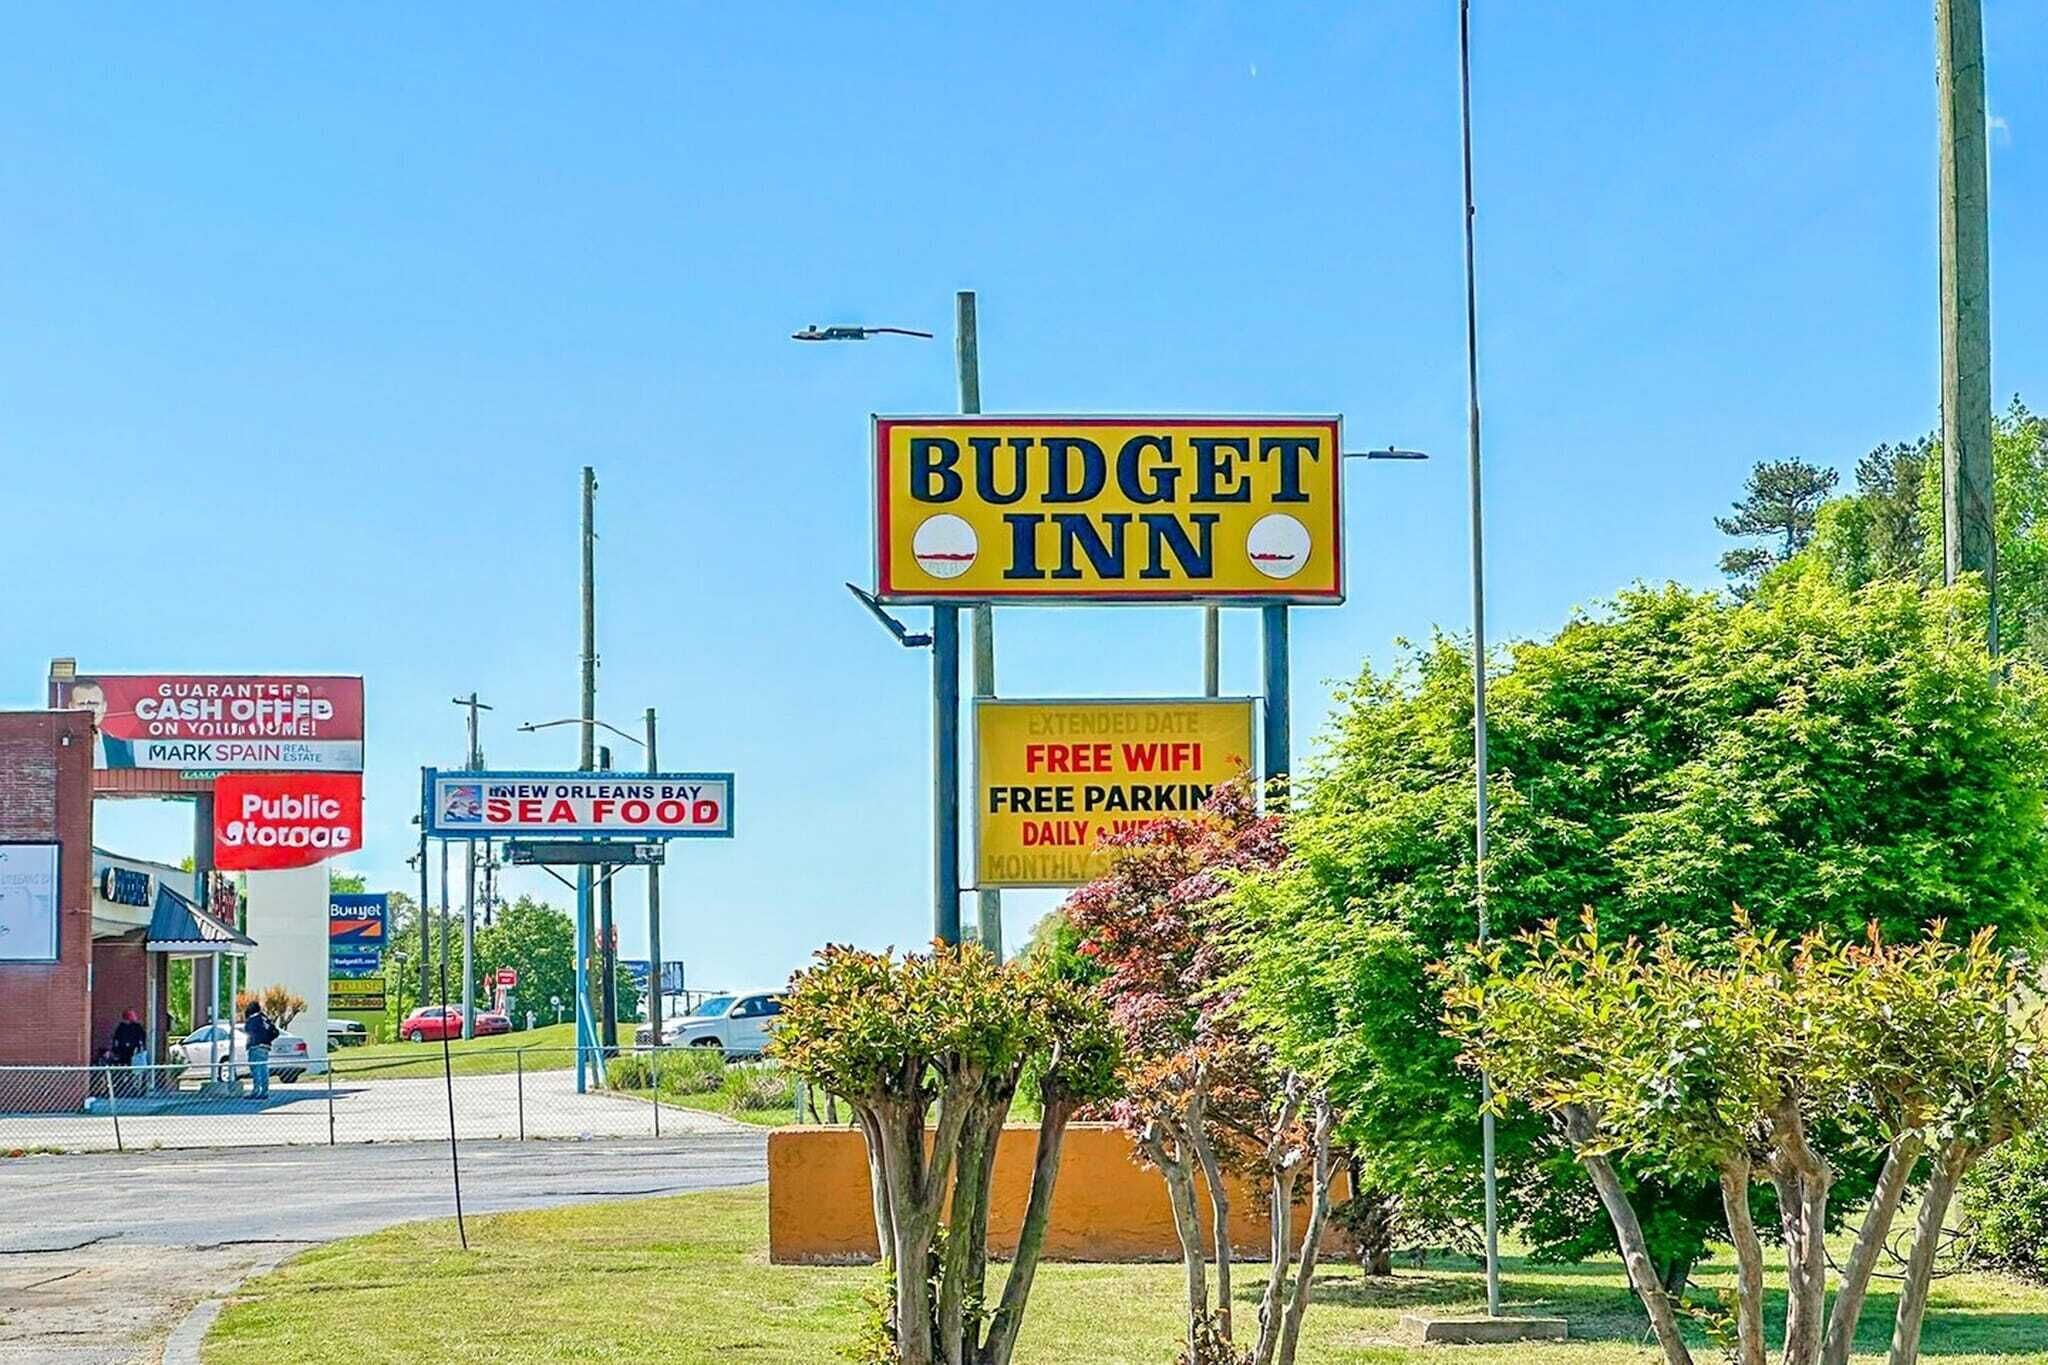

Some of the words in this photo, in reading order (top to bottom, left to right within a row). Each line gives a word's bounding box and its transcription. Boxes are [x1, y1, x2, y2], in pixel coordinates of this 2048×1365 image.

[910, 435, 1320, 505] BUDGET
[1003, 513, 1219, 579] INN
[135, 698, 222, 720] CASH
[149, 722, 178, 735] ON
[1028, 712, 1138, 735] EXTENDED
[1145, 712, 1199, 734] DATE
[149, 744, 211, 761] MARK
[216, 744, 280, 761] SPAIN
[283, 744, 311, 753] REAL
[283, 753, 322, 763] ESTATE
[1026, 743, 1113, 773] FREE
[1123, 743, 1202, 772] WIFI
[502, 785, 548, 798] NEW
[555, 785, 655, 799] ORLEANS
[661, 786, 702, 800] BAY
[989, 785, 1074, 813] FREE
[1085, 784, 1213, 812] PARKIN
[242, 793, 340, 820] Public
[486, 800, 577, 824] SEA
[592, 800, 719, 824] FOOD
[1022, 820, 1089, 846] DAILY
[987, 854, 1091, 879] MONTHLY
